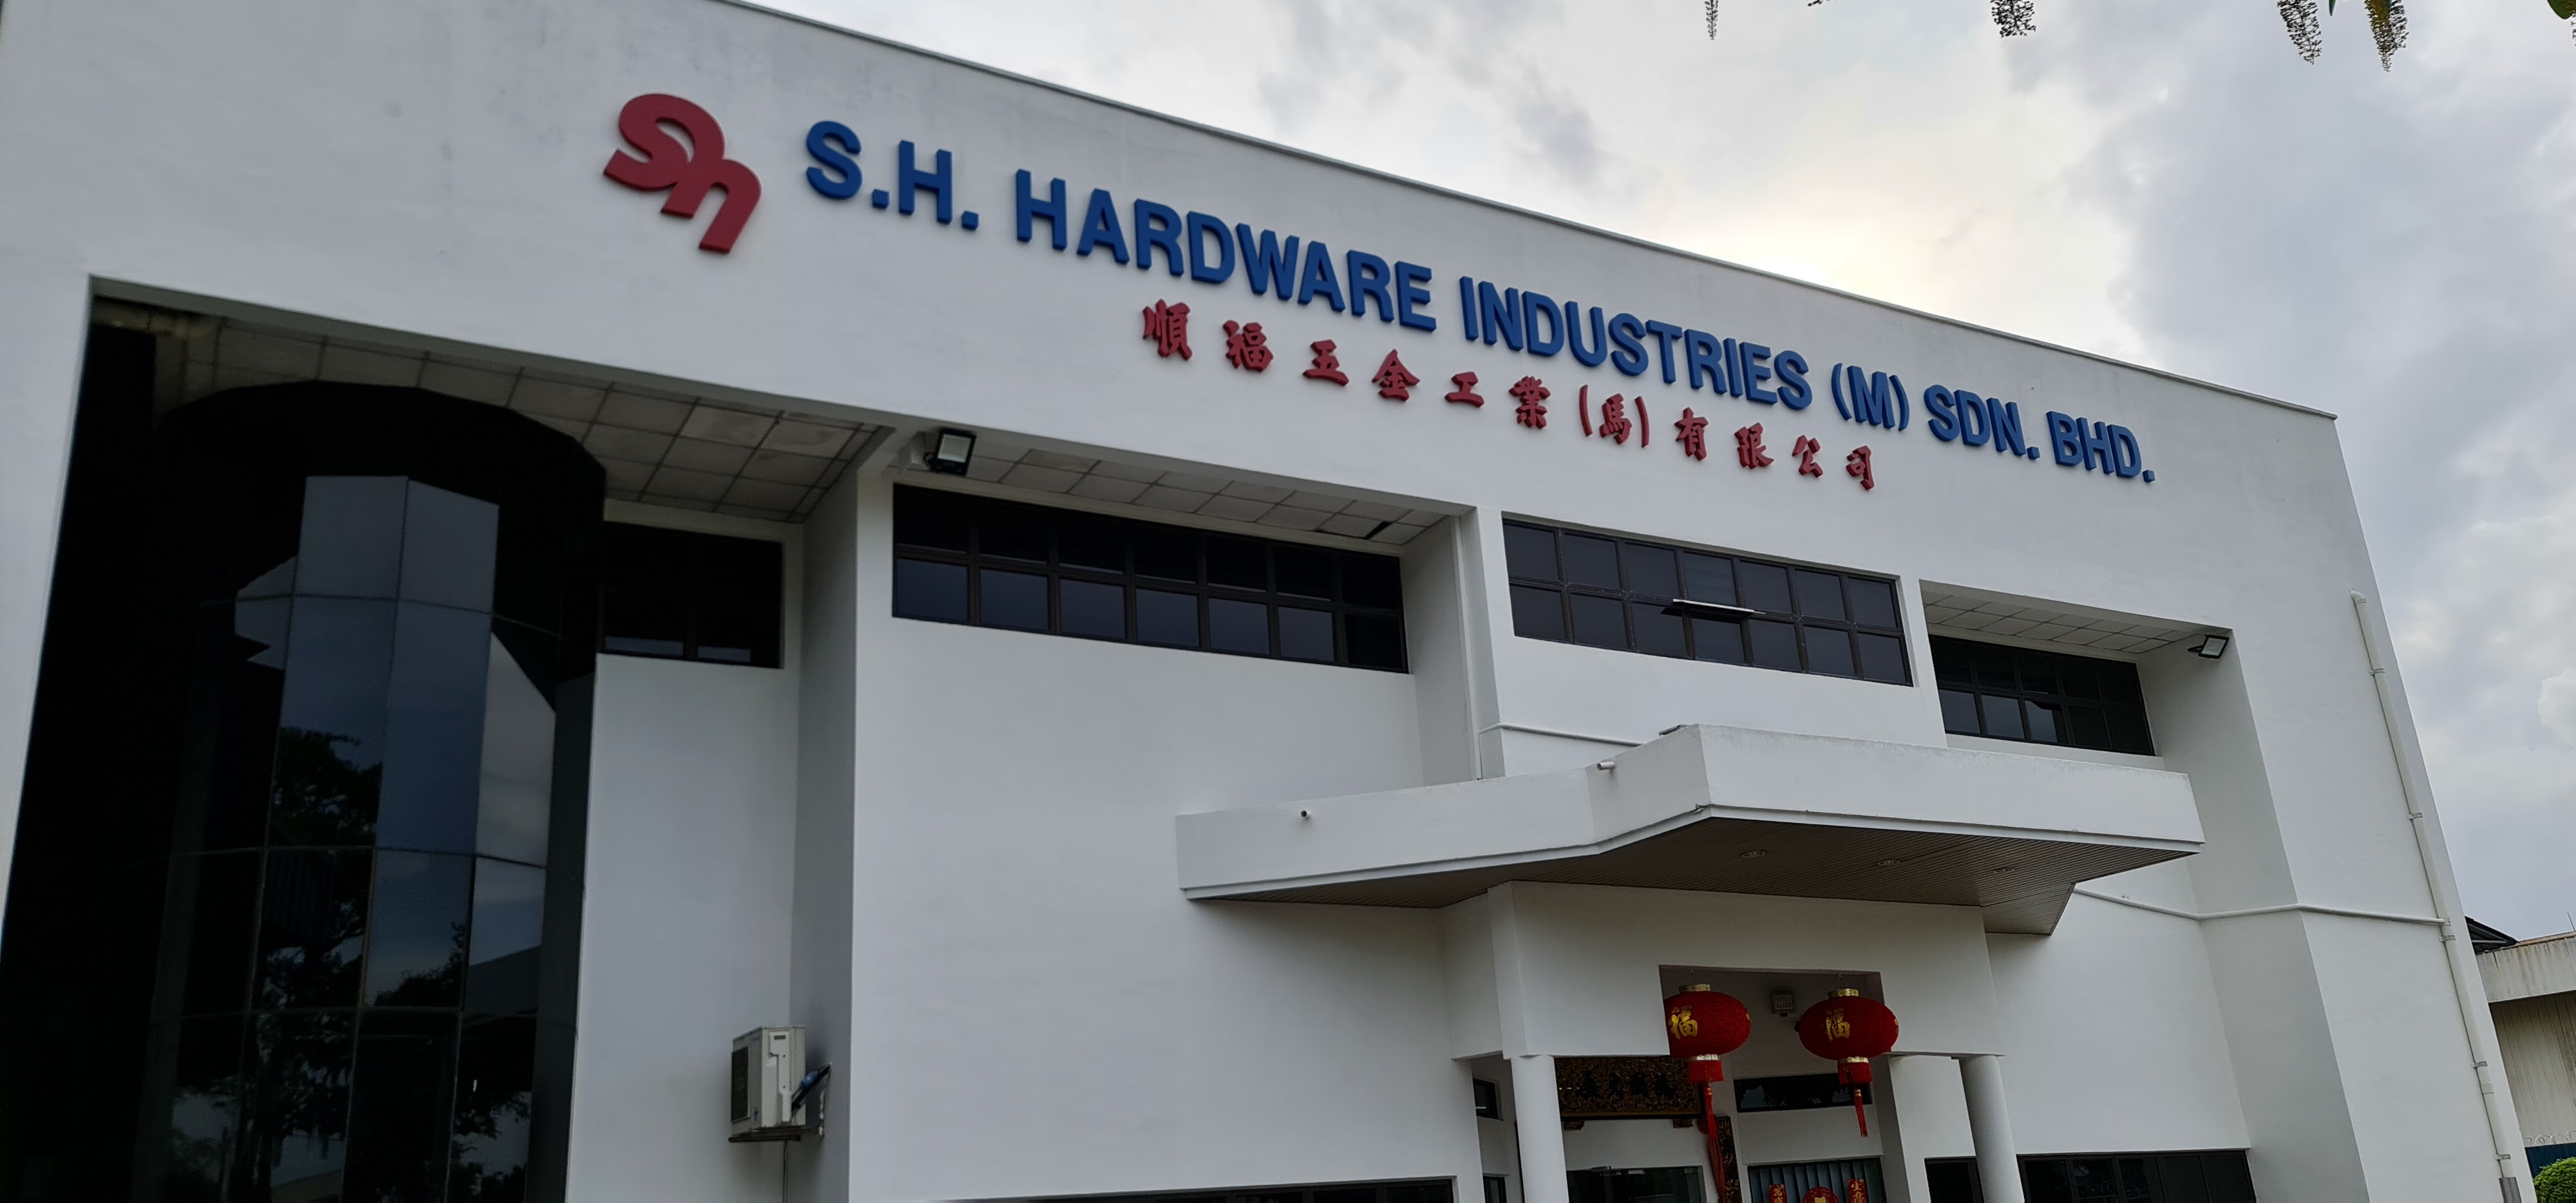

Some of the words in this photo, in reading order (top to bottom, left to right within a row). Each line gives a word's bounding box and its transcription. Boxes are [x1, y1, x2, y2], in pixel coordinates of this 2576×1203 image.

[806, 120, 979, 231] S.H.
[1015, 169, 1437, 333] HARDWARE
[1459, 276, 1812, 411] INDUSTRIES
[1831, 363, 1910, 431] (M)
[1923, 384, 2040, 460] SDN.
[2046, 410, 2155, 483] BHD.
[1667, 1004, 1698, 1039] 福
[1825, 1007, 1850, 1041] 福
